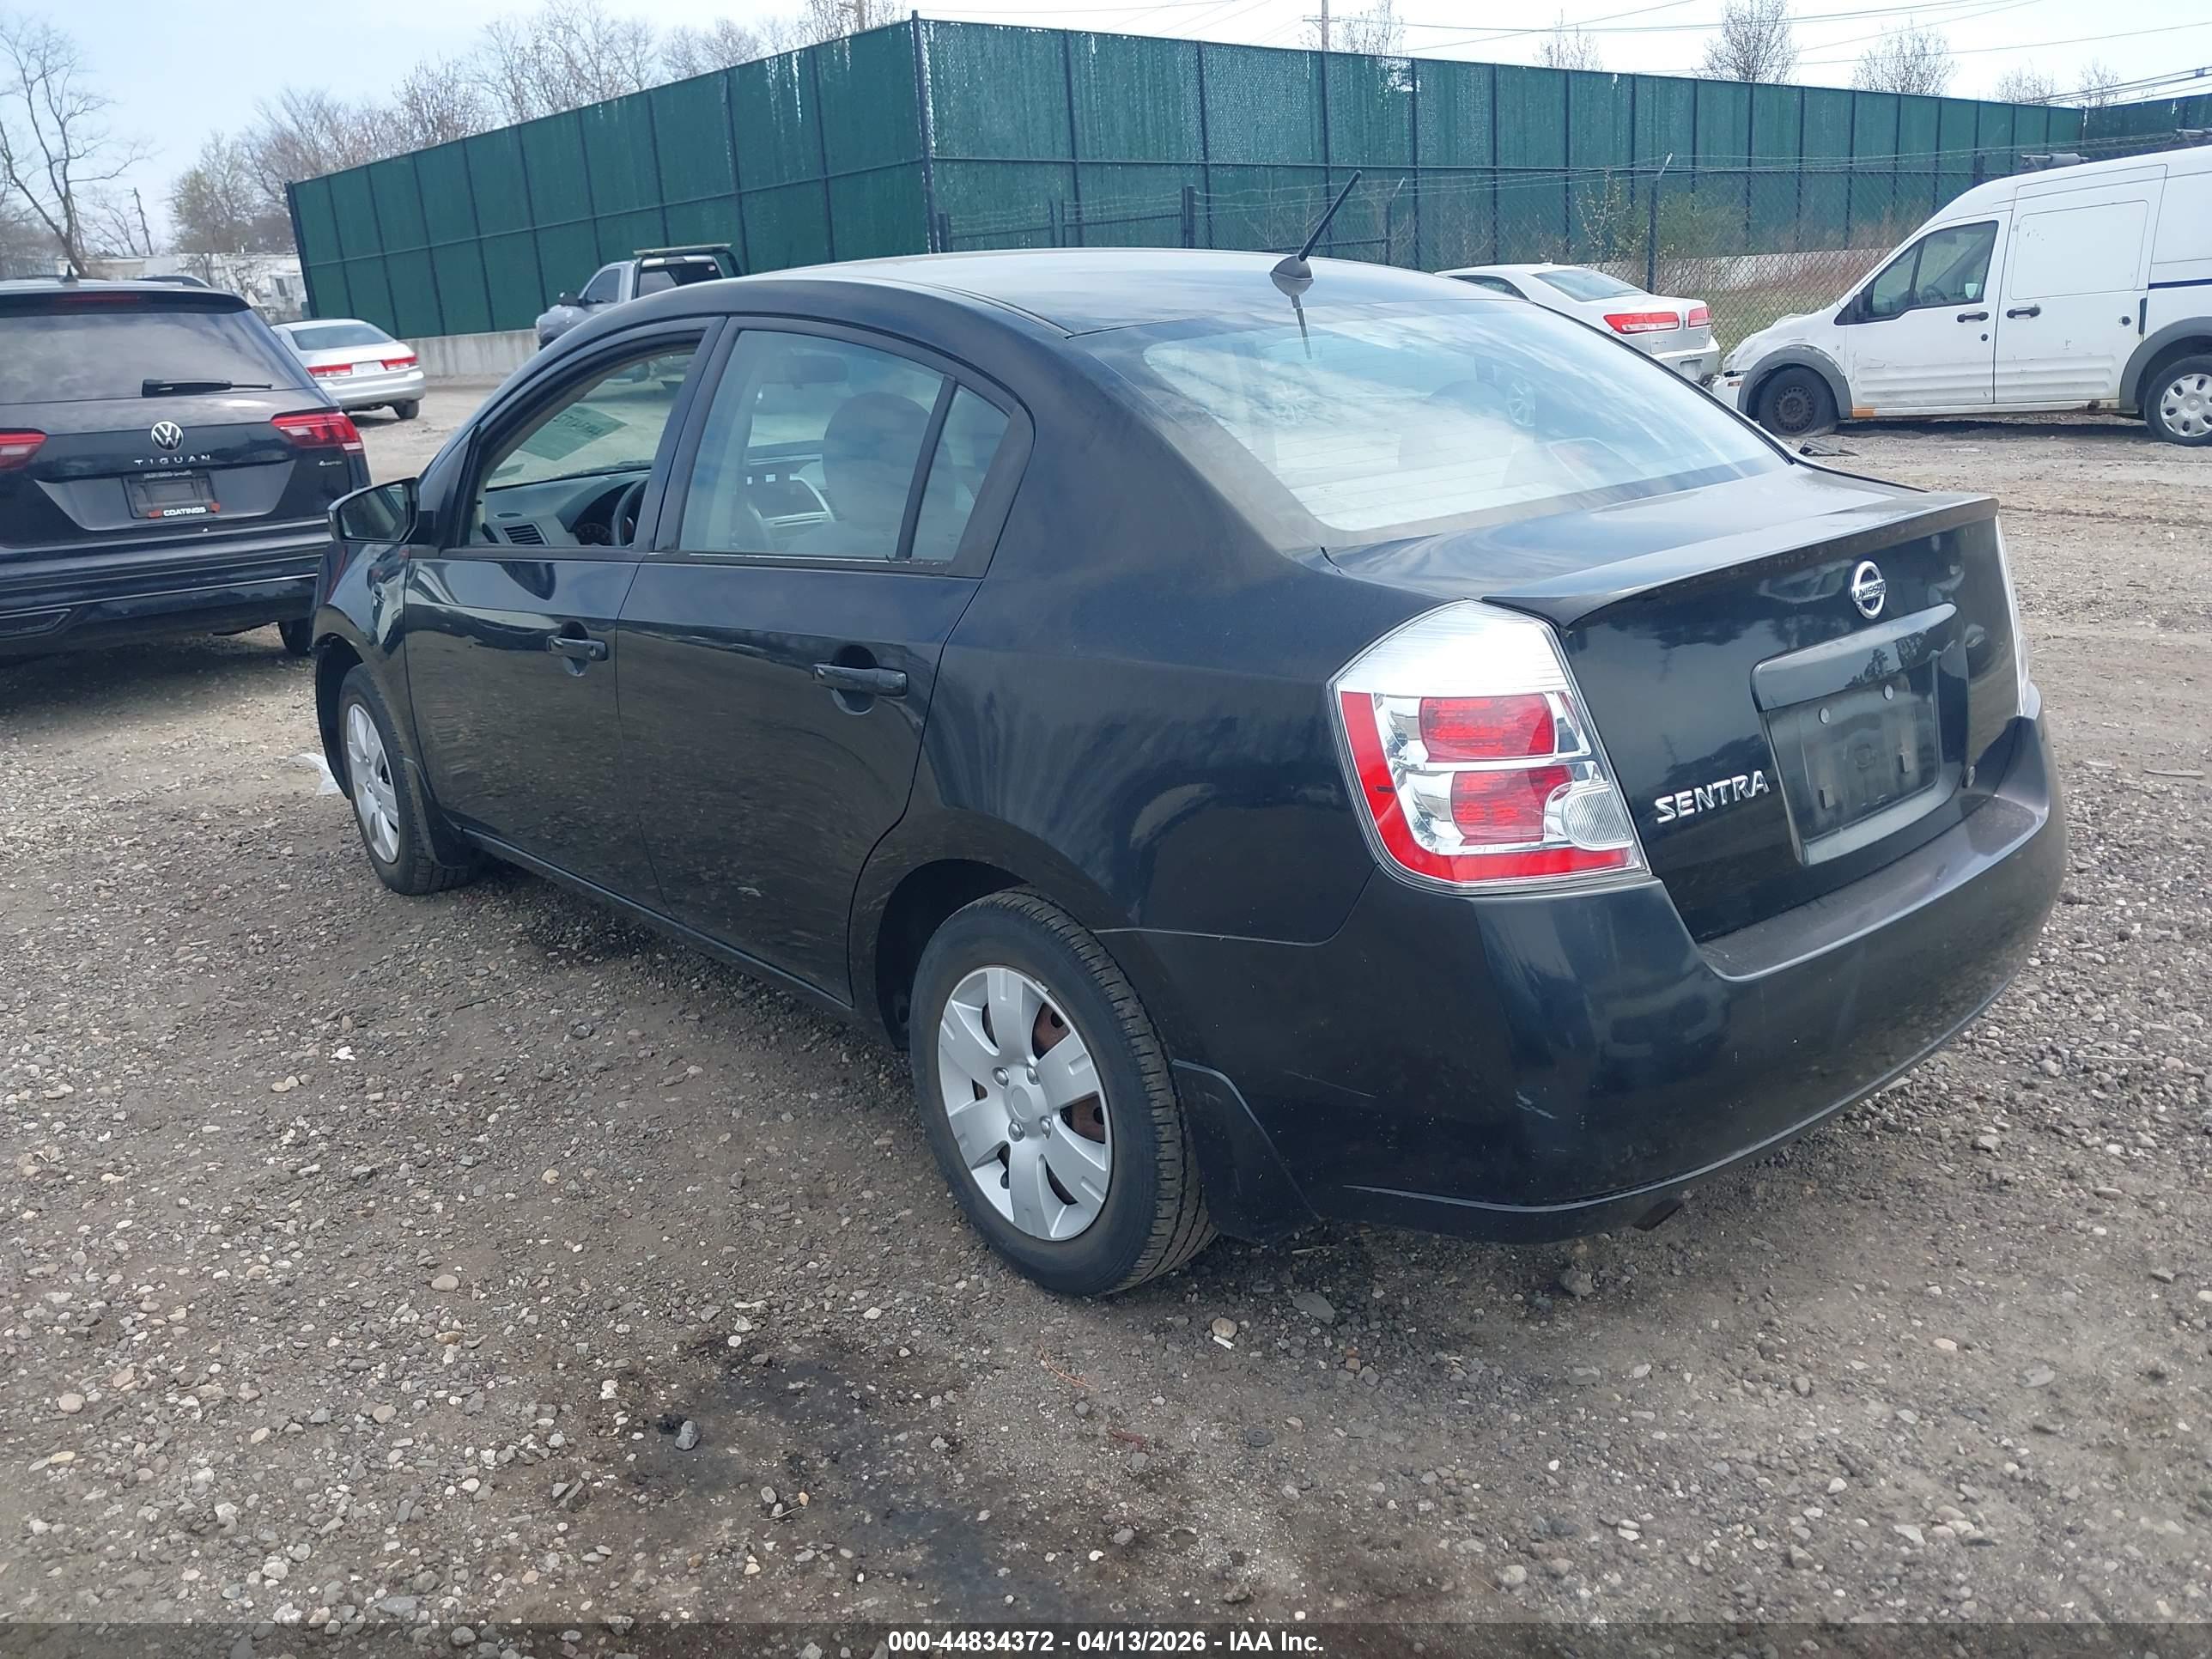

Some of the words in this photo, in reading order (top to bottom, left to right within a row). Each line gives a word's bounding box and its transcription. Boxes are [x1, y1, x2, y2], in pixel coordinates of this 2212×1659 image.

[134, 454, 210, 465] TIGUAN
[163, 507, 206, 517] COATINGS
[1857, 580, 1885, 599] NISSAN
[1654, 769, 1770, 824] SENTRA
